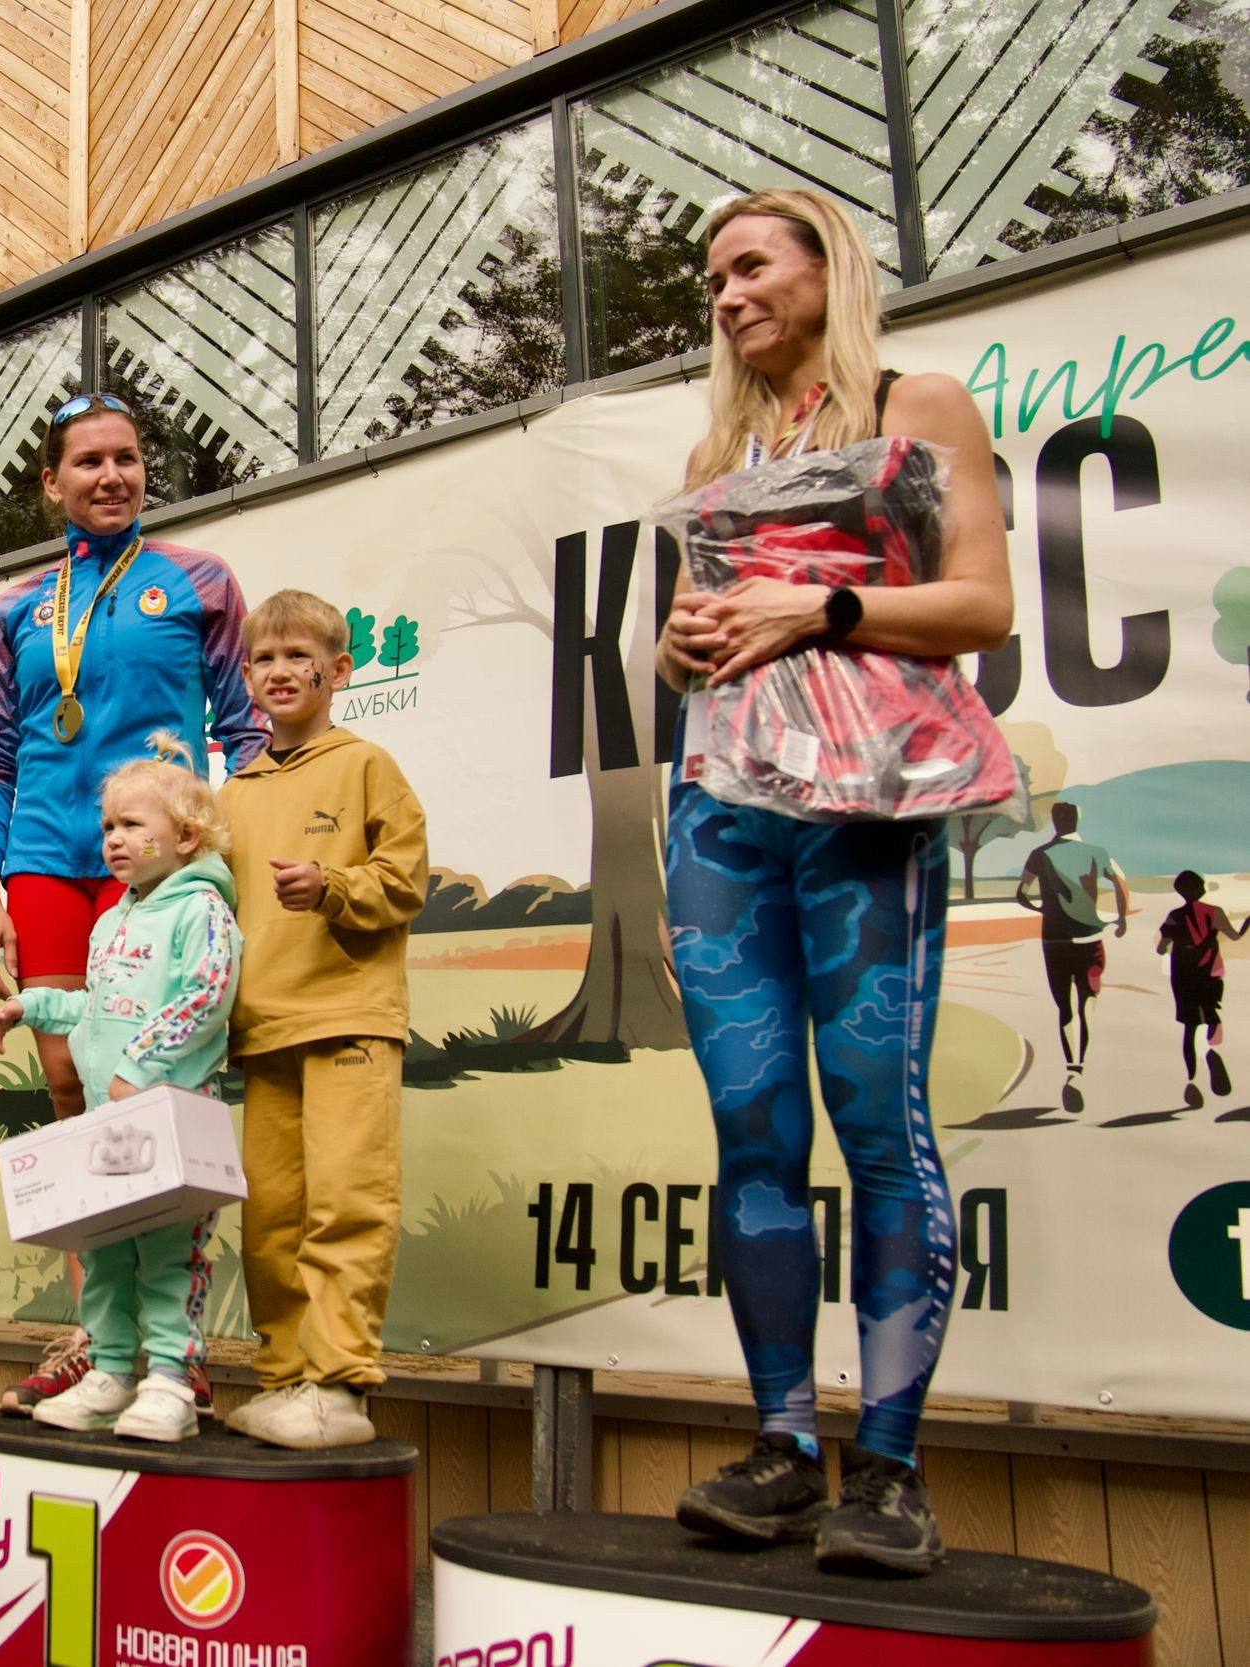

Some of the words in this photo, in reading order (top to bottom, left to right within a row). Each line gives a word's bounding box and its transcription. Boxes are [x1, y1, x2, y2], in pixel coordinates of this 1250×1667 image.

[965, 317, 1250, 440] Апре
[342, 686, 418, 721] ДУБКИ
[305, 824, 334, 835] PUMA
[334, 1055, 367, 1067] PUMA
[527, 1182, 596, 1291] 14
[28, 1491, 99, 1667] 1
[116, 1623, 199, 1667] НОВАЯ
